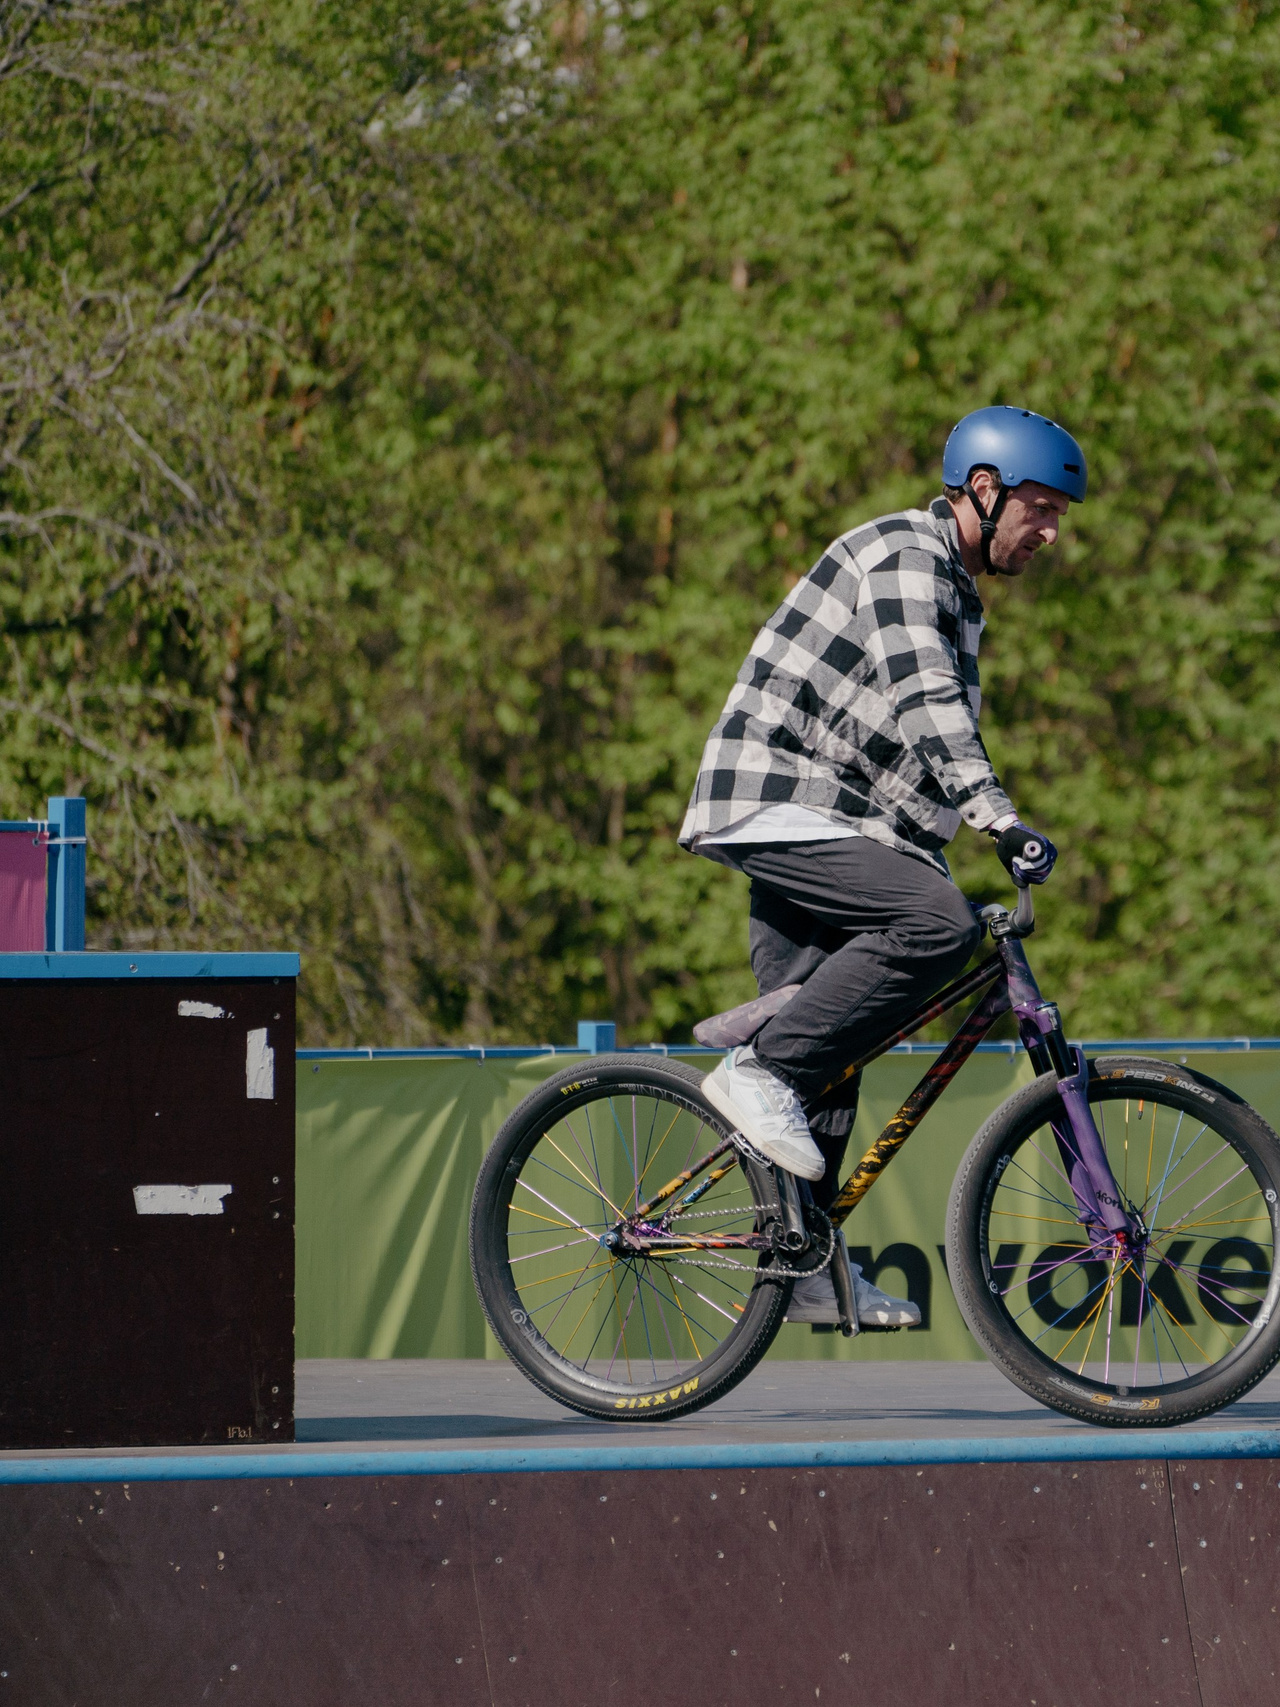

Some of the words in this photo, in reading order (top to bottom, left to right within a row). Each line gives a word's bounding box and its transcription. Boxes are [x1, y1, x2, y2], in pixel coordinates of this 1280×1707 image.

[1111, 1069, 1202, 1095] SPEEDKING
[812, 1211, 1272, 1334] noke
[614, 1376, 700, 1409] MAXXIS
